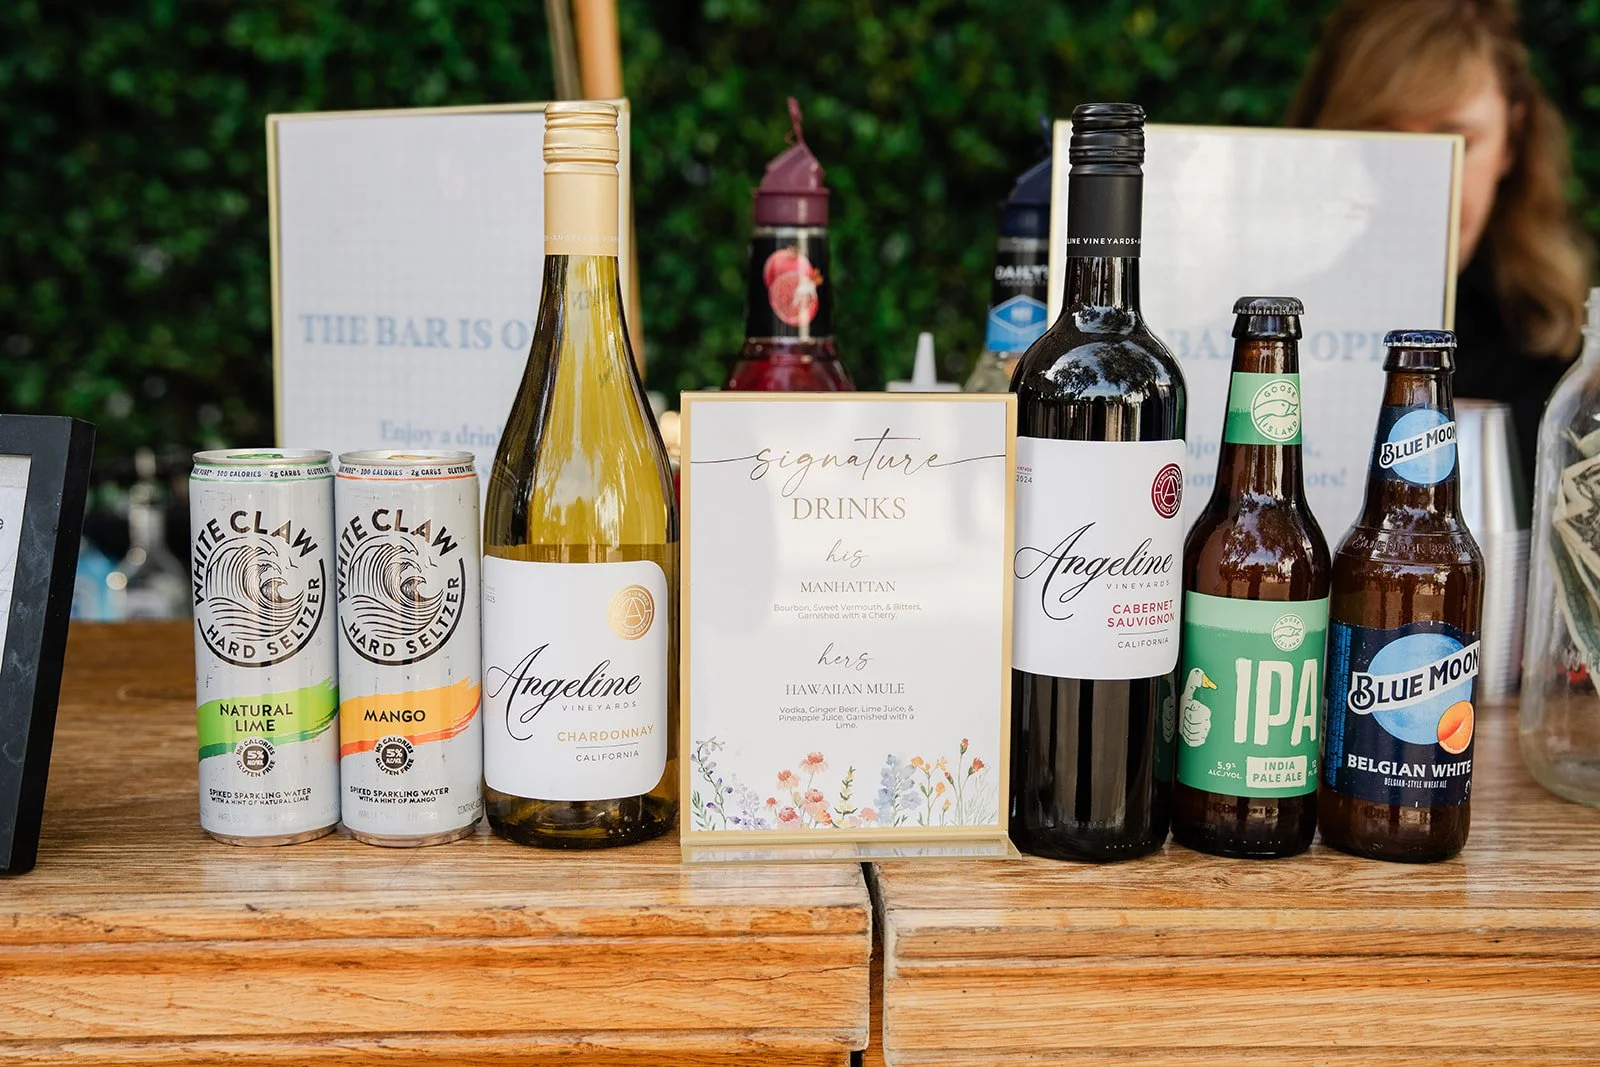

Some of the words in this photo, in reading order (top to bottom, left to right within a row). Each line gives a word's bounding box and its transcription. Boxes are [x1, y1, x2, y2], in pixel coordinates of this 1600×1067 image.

[300, 313, 368, 346] THE
[375, 314, 450, 348] BAR
[459, 317, 494, 350] IS
[1264, 385, 1297, 398] GOOSE
[379, 419, 436, 447] Enjoy
[456, 423, 503, 445] drin
[1263, 420, 1298, 436] ISLAND
[1380, 440, 1423, 466] BLUE
[690, 428, 1006, 498] signature
[229, 470, 262, 478] CALORIES
[270, 470, 279, 478] 2g
[280, 469, 301, 477] CARBS
[411, 469, 420, 477] 2g
[791, 496, 906, 521] DRINKS
[193, 517, 226, 607] WHITE
[229, 510, 319, 558] CLAW
[336, 515, 368, 604] WHITE
[371, 508, 459, 557] CLAW
[825, 538, 869, 568] his
[1013, 521, 1174, 621] Angeline
[799, 580, 897, 593] MANHATTAN
[1106, 579, 1171, 590] VINEYARDS
[773, 603, 811, 612] Bourbon,
[813, 603, 839, 612] Sweet
[840, 602, 884, 612] Vermouth,
[885, 603, 892, 611] &
[893, 602, 922, 611] Bitters,
[1112, 599, 1174, 615] CABERNET
[206, 624, 256, 659] HARD
[266, 576, 321, 656] SELTZER
[349, 622, 396, 657] HARD
[405, 576, 460, 655] SELTZER
[797, 611, 840, 620] Garnished
[841, 611, 860, 620] with
[868, 611, 897, 621] Cherry
[1107, 611, 1175, 628] SAUVIGNON
[1117, 637, 1169, 649] CALIFORNIA
[817, 642, 873, 671] hers
[1349, 674, 1424, 710] BLUE
[1429, 646, 1480, 691] MOON
[485, 643, 642, 741] Angeline
[785, 683, 863, 696] HAWAIIAN
[866, 682, 905, 695] MULE
[561, 700, 638, 712] VINEYARDS
[1233, 657, 1318, 747] IPA
[219, 703, 294, 717] NATURAL
[363, 709, 426, 723] MANGO
[779, 705, 807, 714] Vodka,
[808, 705, 837, 715] Ginger
[838, 705, 860, 714] Beer,
[861, 704, 882, 713] Lime
[883, 704, 907, 714] Juice,
[907, 704, 914, 712] &
[778, 714, 820, 723] Pineapple
[821, 713, 845, 723] Juice,
[846, 713, 888, 721] Garnished
[889, 712, 908, 720] with
[235, 719, 276, 732] LIME
[835, 721, 858, 730] Lime.
[556, 723, 655, 743] CHARDONNAY
[243, 738, 276, 756] CALORIES
[382, 736, 414, 754] CALORIES
[246, 750, 265, 760] 5%
[386, 748, 403, 758] 5%
[575, 749, 640, 762] CALIFORNIA
[236, 760, 262, 778] GLUTEN
[262, 759, 276, 776] FREE
[375, 757, 400, 776] GLUTEN
[400, 758, 415, 774] FREE
[1217, 761, 1236, 771] 5.9%
[1264, 761, 1295, 771] INDIA
[1347, 753, 1426, 777] BELGIAN
[1431, 759, 1472, 777] WHITE
[1252, 773, 1281, 783] PALE
[1284, 771, 1302, 782] ALE
[209, 788, 232, 799] SPIKED
[234, 791, 281, 799] SPARKLING
[283, 787, 312, 798] WATER
[350, 785, 372, 796] SPIKED
[373, 789, 419, 798] SPARKLING
[421, 786, 449, 797] WATER
[294, 795, 309, 803] LIME
[358, 795, 373, 803] WITH
[408, 796, 436, 804] MANGO
